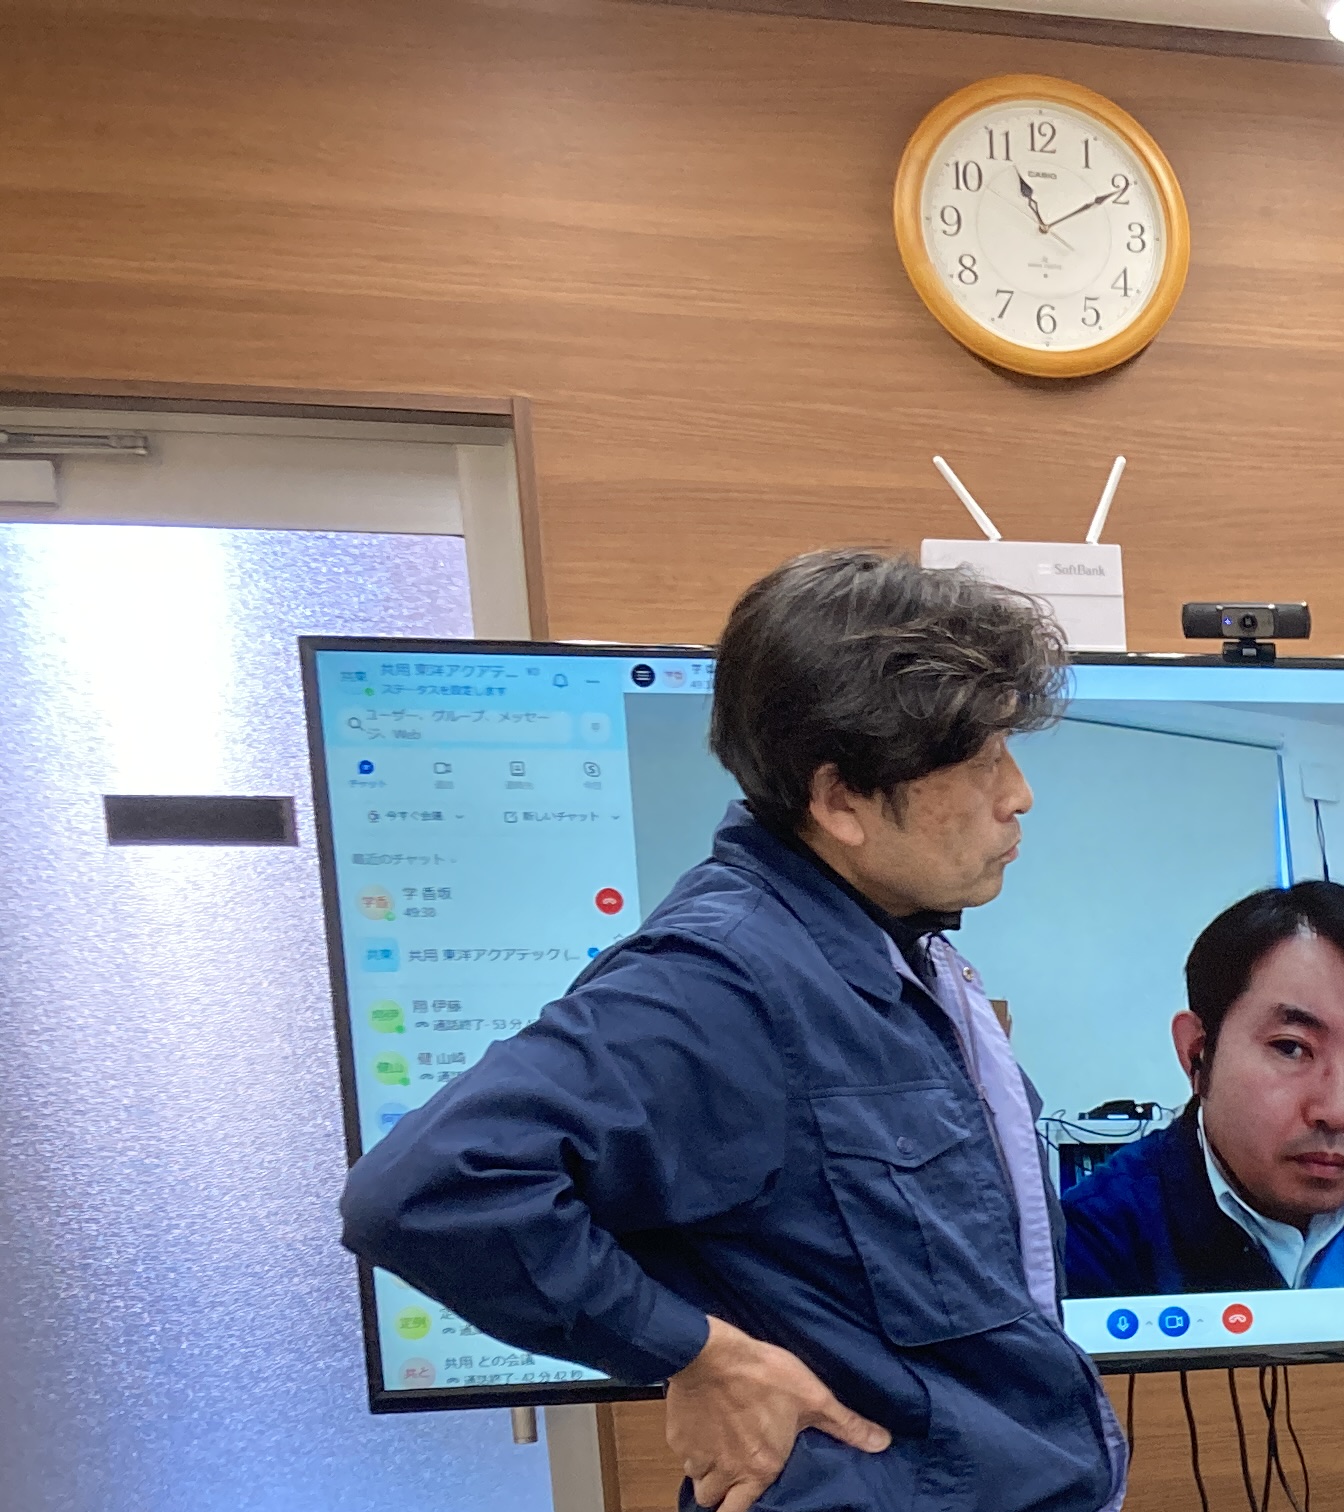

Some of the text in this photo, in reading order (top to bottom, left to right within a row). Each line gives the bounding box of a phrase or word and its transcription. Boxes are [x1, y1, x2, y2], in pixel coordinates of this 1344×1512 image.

[987, 128, 1014, 162] 11
[1027, 121, 1057, 154] 12
[1081, 136, 1092, 170] 1
[951, 160, 984, 193] 10
[1027, 169, 1058, 181] CASIO
[1110, 173, 1130, 206] 2
[939, 205, 962, 237] 9
[1125, 222, 1146, 254] 3
[957, 253, 979, 286] 8
[1110, 266, 1130, 298] 4
[994, 289, 1014, 320] 7
[1036, 303, 1057, 335] 6
[1081, 296, 1102, 327] 5
[1054, 563, 1106, 578] SoftBank
